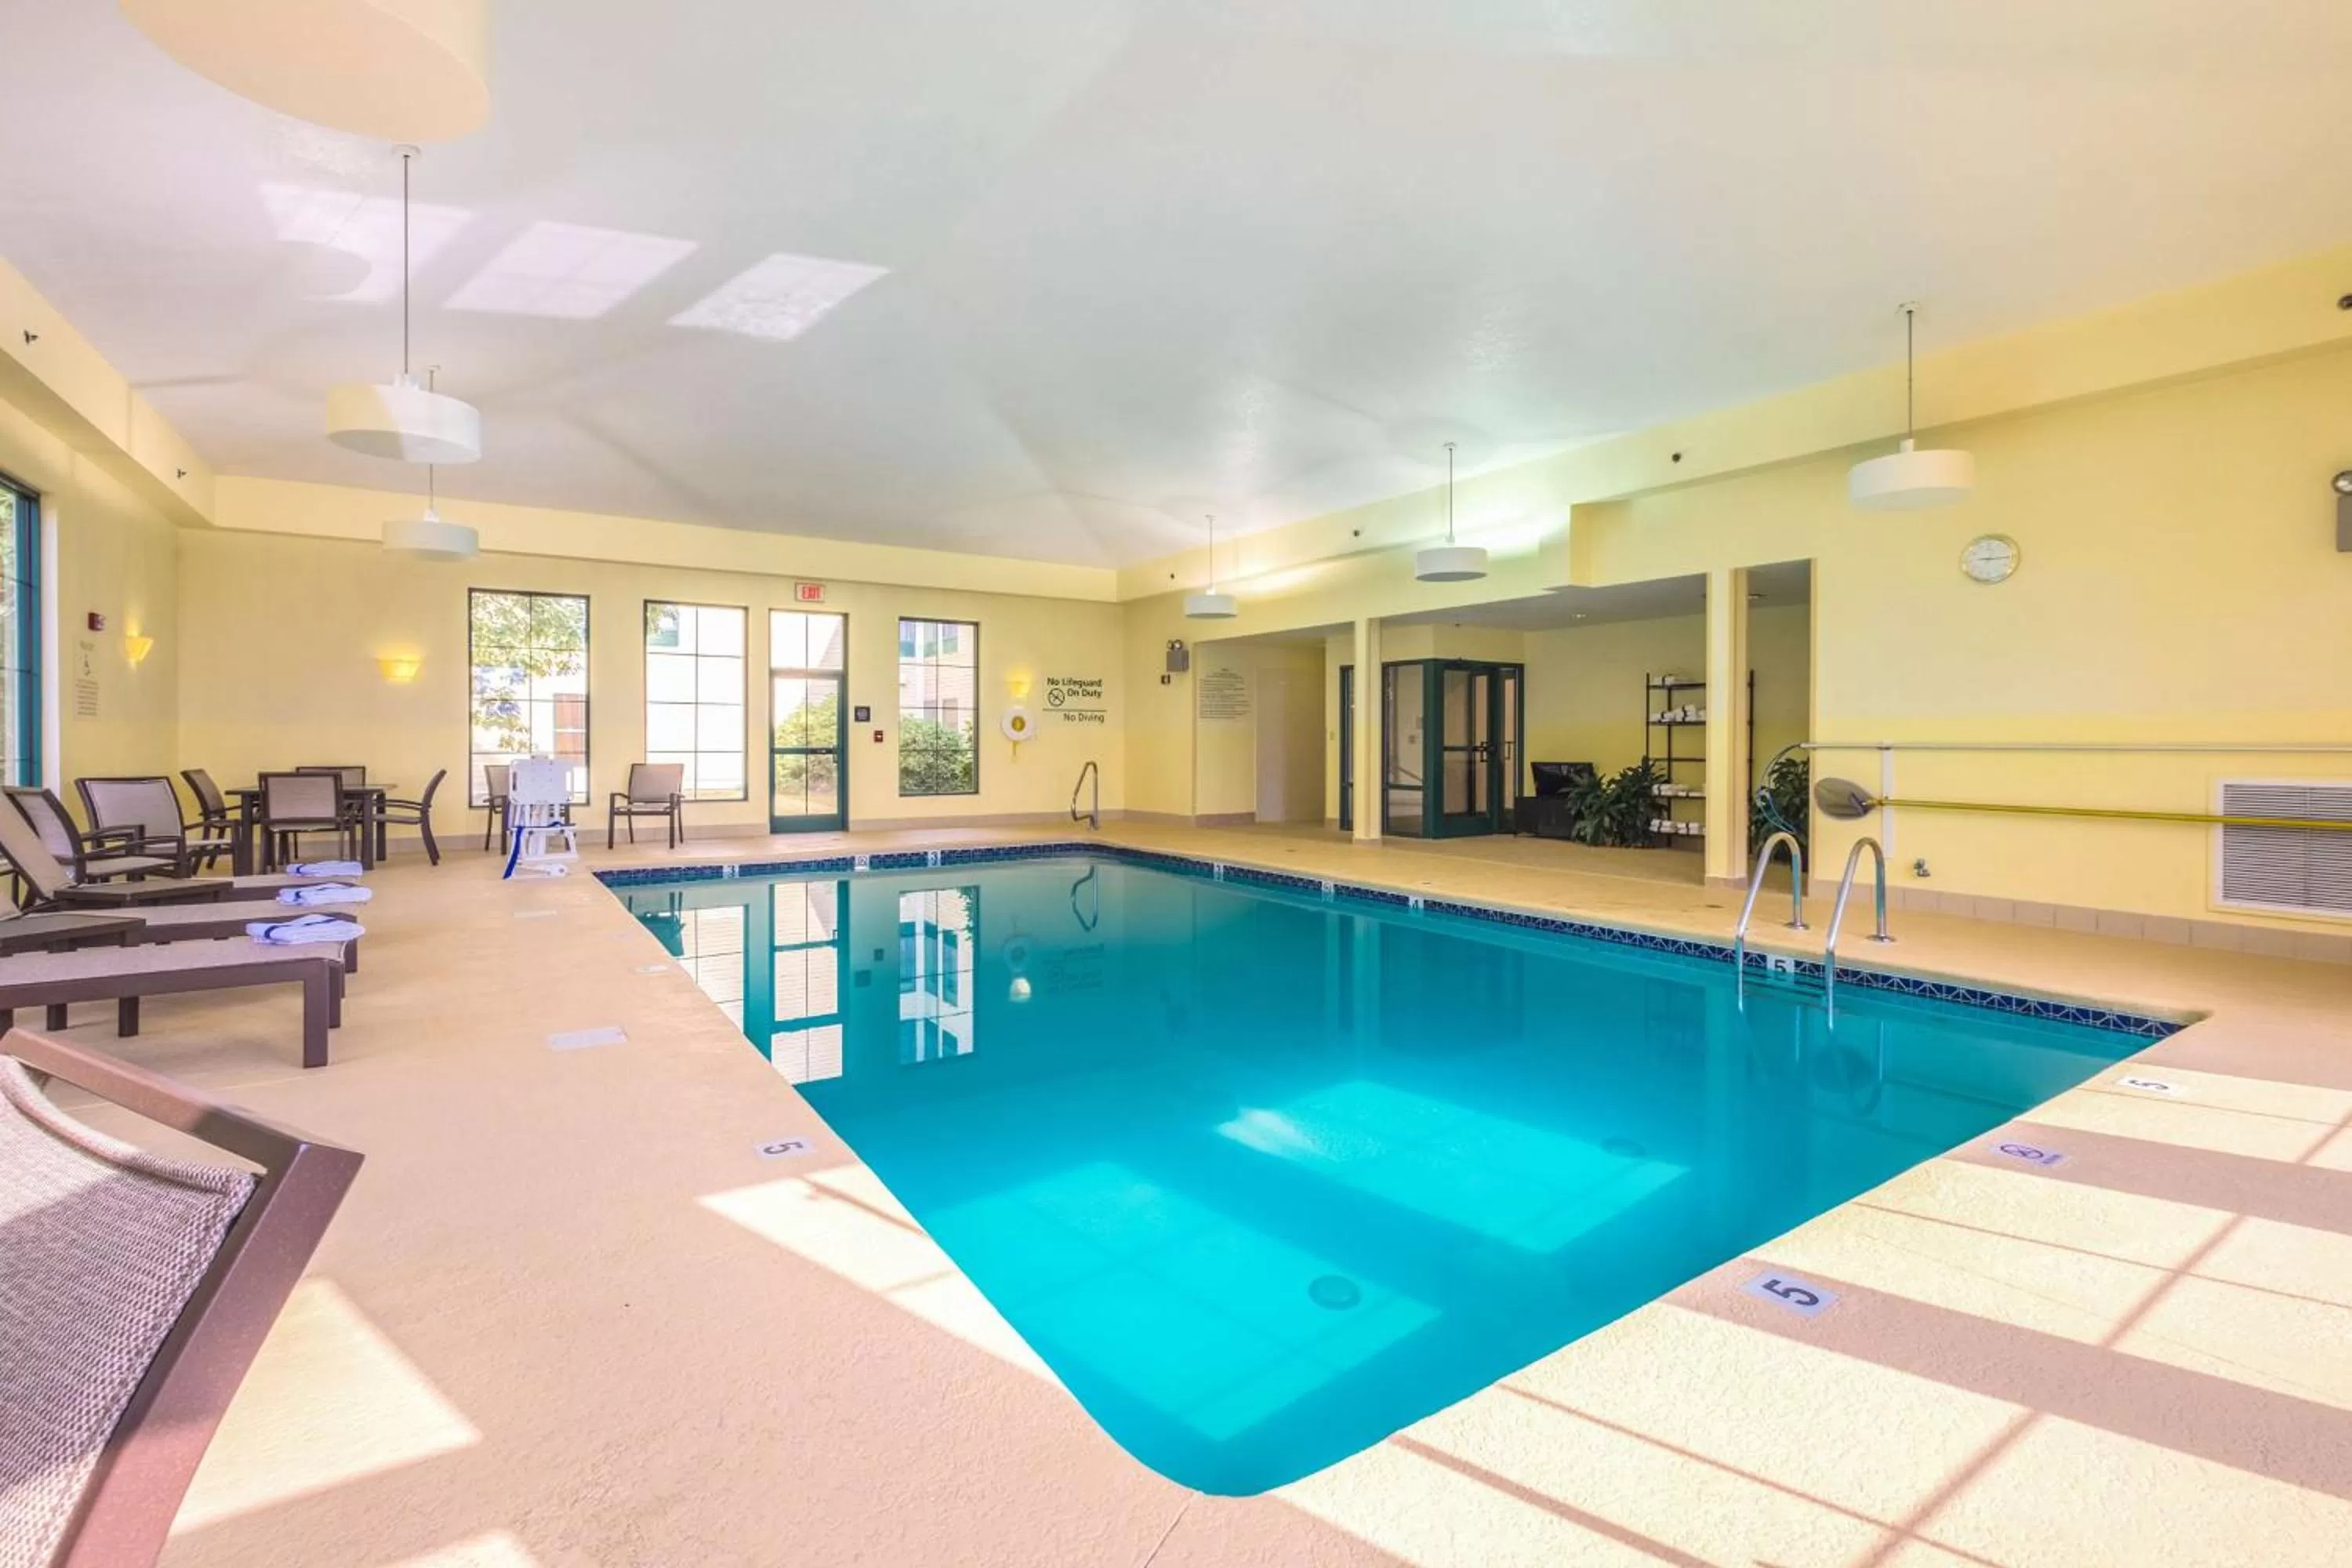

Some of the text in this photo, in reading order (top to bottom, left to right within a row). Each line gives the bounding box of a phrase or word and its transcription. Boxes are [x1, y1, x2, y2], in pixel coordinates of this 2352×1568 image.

[1047, 677, 1102, 688] No Lifeguard
[1067, 688, 1102, 699] On Duty
[1063, 713, 1105, 723] No Diving
[2128, 1079, 2169, 1091] 5
[763, 1142, 804, 1155] 5
[1762, 1279, 1820, 1306] 5
